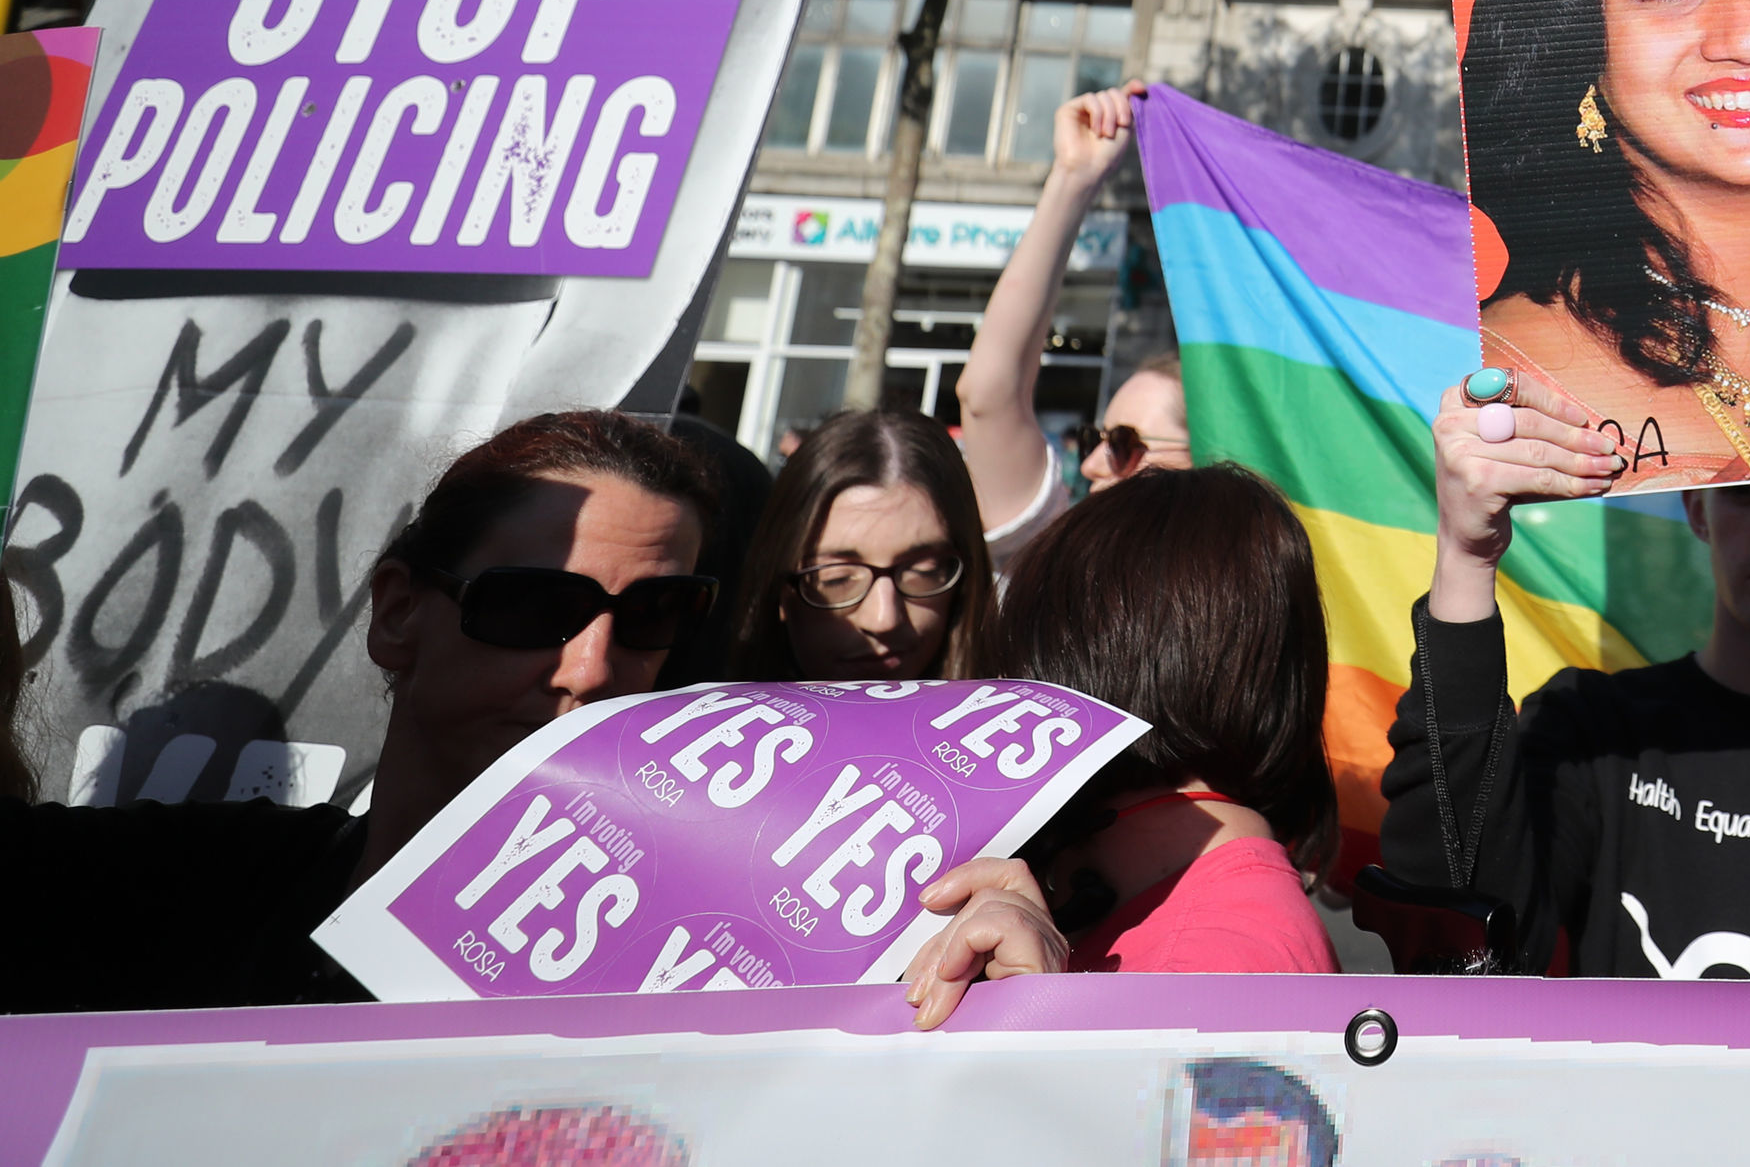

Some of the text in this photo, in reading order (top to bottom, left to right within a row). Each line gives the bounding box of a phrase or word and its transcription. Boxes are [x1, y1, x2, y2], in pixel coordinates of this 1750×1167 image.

[62, 74, 678, 250] POLICING
[119, 318, 416, 481] MY
[3, 474, 414, 724] BODY
[766, 694, 817, 726] voting
[929, 685, 1083, 780] YES
[1030, 689, 1078, 720] voting
[640, 691, 814, 809] YES
[931, 740, 979, 779] ROSA
[635, 760, 688, 809] ROSA
[895, 781, 948, 835] voting
[591, 811, 645, 874] voting
[770, 763, 945, 935] YES
[454, 794, 640, 982] YES
[768, 886, 820, 937] ROSA
[453, 930, 507, 983] ROSA
[729, 944, 784, 988] votin
